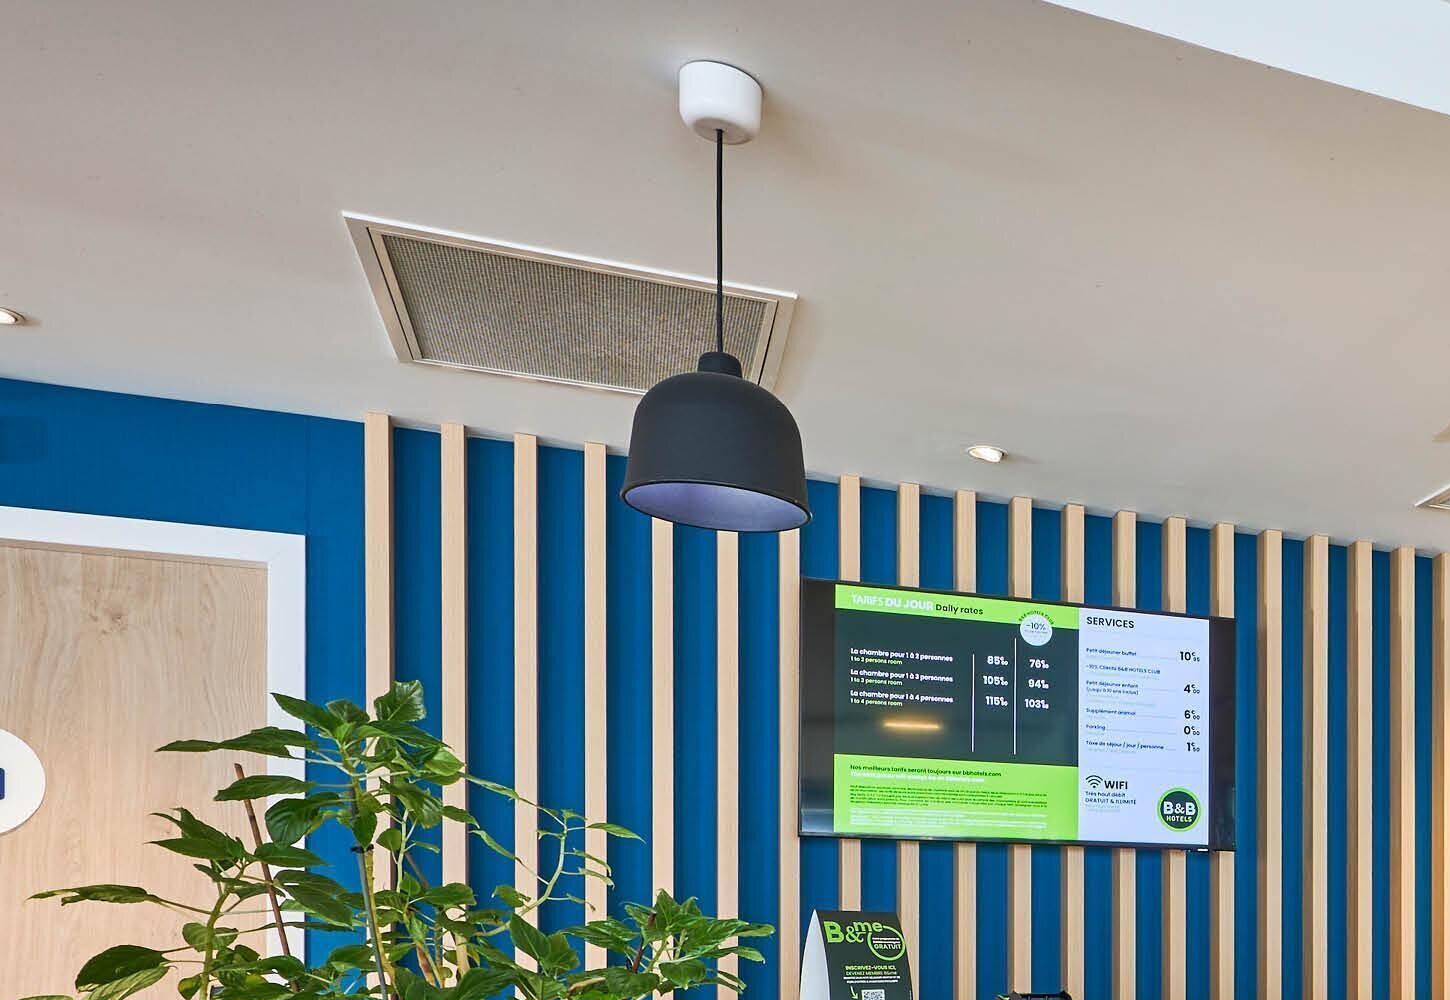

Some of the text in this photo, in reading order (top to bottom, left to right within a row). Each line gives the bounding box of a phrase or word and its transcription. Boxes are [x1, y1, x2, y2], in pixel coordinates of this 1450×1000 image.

[1026, 622, 1046, 631] -10%
[1086, 616, 1134, 628] SERVICES
[1105, 780, 1128, 790] WIFI
[1164, 801, 1196, 816] B&B
[824, 921, 882, 943] B&me
